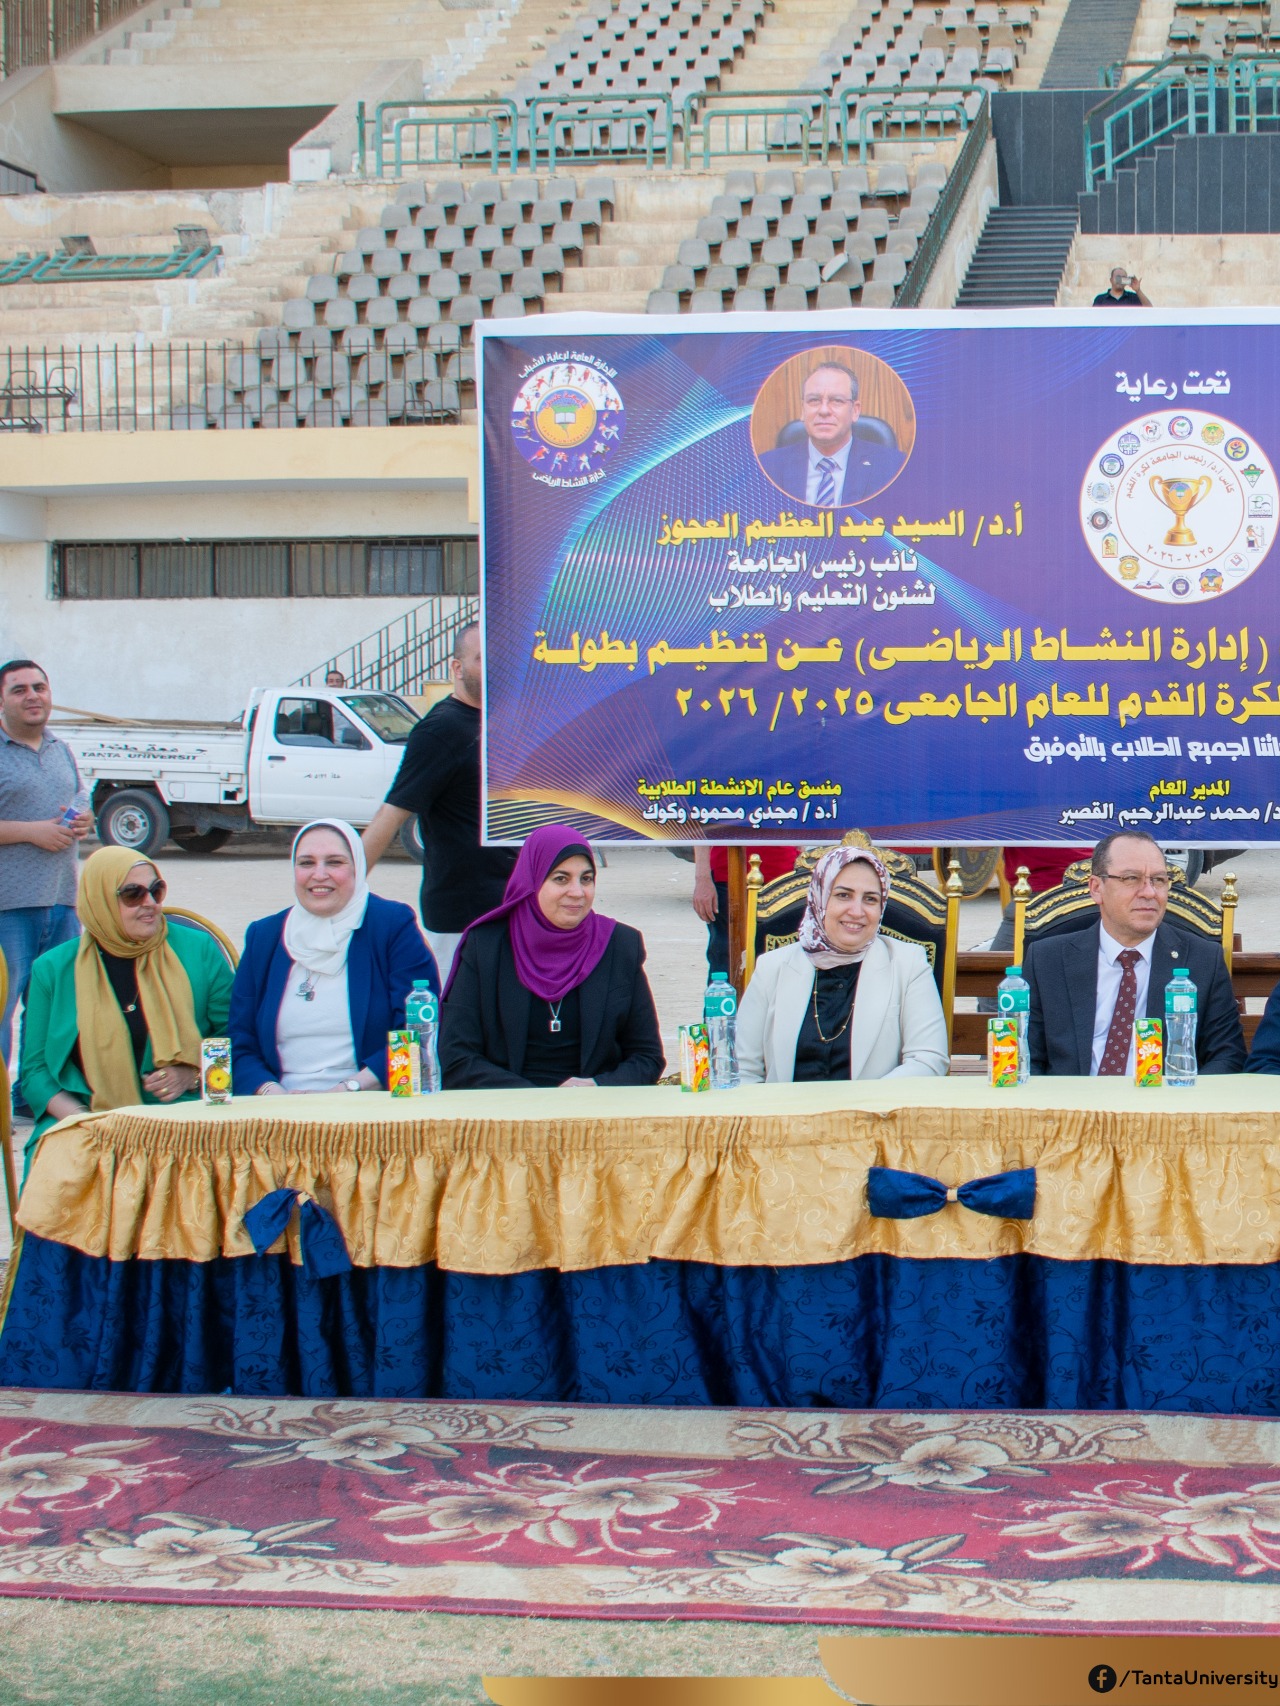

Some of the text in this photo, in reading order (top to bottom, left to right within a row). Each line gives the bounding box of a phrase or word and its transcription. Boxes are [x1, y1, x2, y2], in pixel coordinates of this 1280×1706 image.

[1115, 370, 1231, 402] تحت رعاية
[657, 512, 738, 546] العجوز
[745, 510, 833, 546] العظيم
[840, 515, 886, 542] عبد
[892, 509, 965, 542] السيد
[727, 548, 917, 579] نائب رئيس الجامعة
[709, 581, 936, 612] لشئون التعليم والطلاب
[532, 629, 639, 672] بطولة
[647, 629, 769, 675] تنظيم
[776, 637, 844, 671] عن
[1030, 626, 1161, 662] النشاط
[884, 682, 1018, 725] الجامعى
[1026, 682, 1110, 729] للعام
[1119, 681, 1206, 728] القدم
[1023, 734, 1106, 764] بالتوفيق
[1111, 736, 1182, 761] الطلاب
[1187, 736, 1250, 765] لجميع
[637, 778, 842, 802] منسق عام الانشطة الطلابية
[1149, 779, 1230, 801] المدير العام
[643, 802, 687, 824] وكوك
[690, 806, 745, 824] محمود
[749, 805, 798, 828] مجدي
[1058, 802, 1113, 825] القصير
[1210, 803, 1260, 821] محمد
[994, 1045, 1016, 1054] Mango
